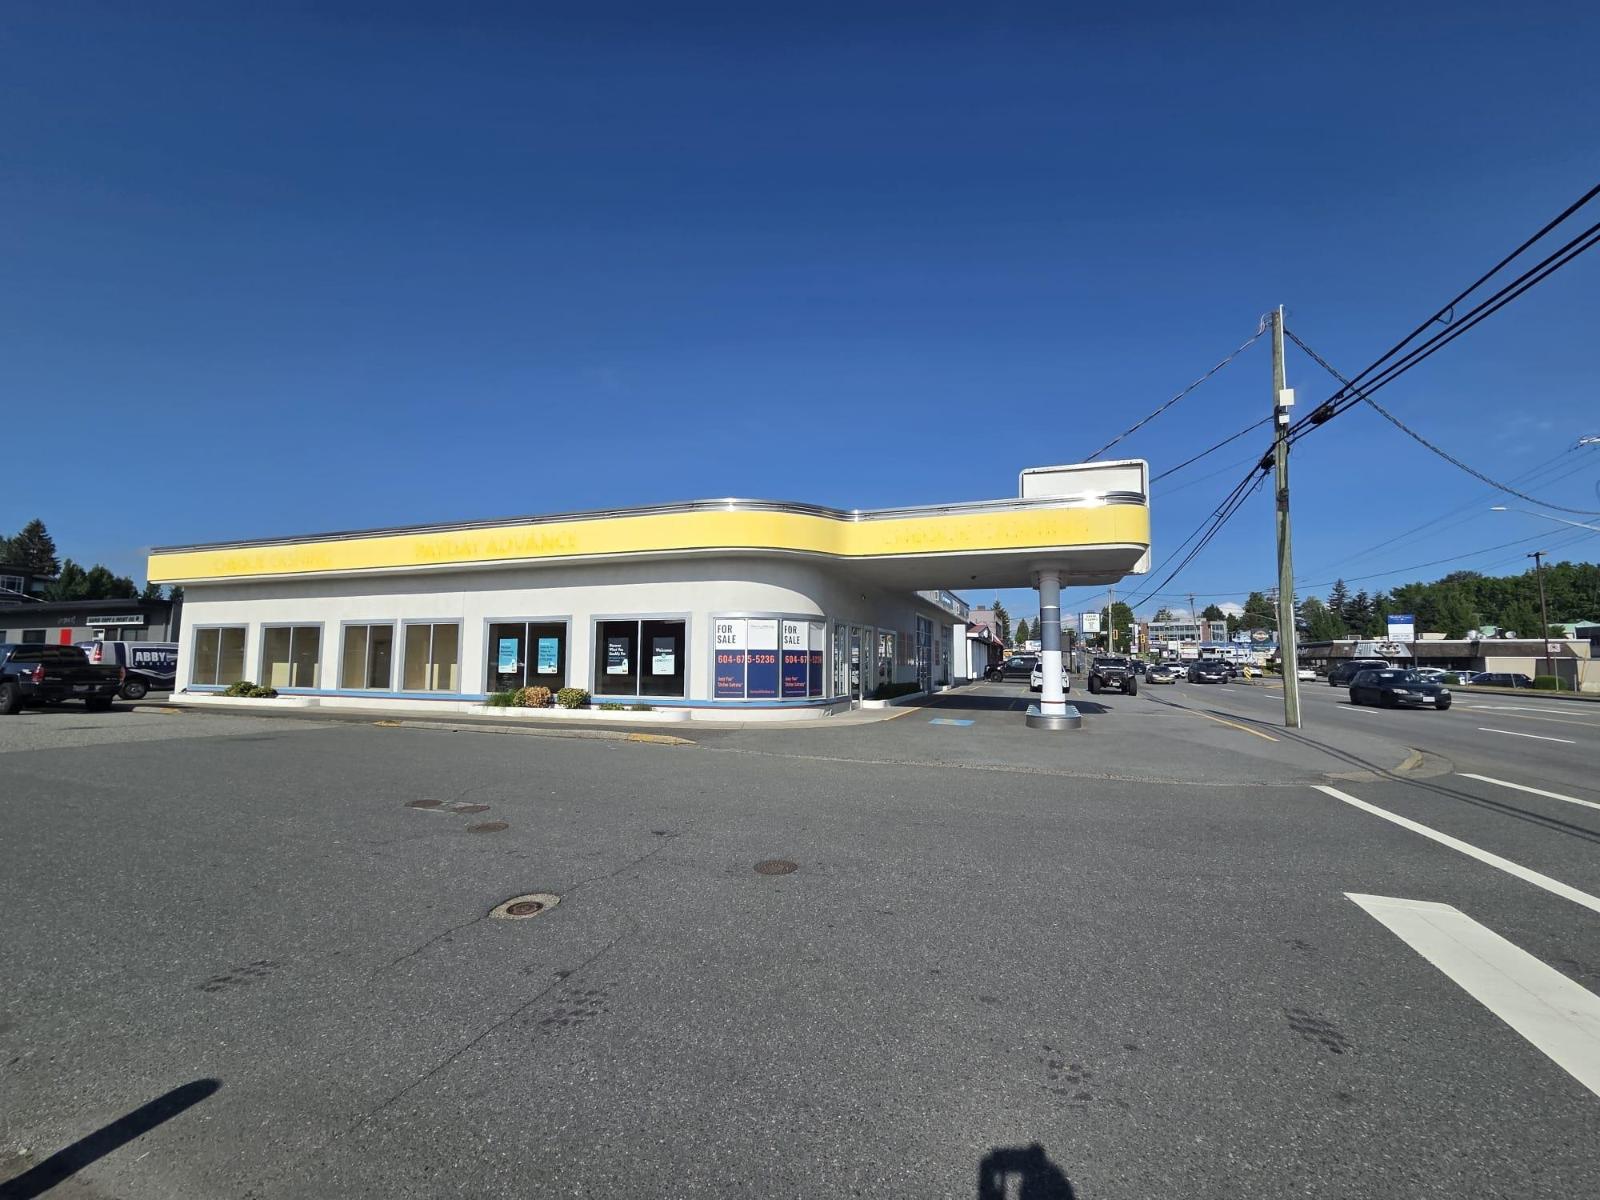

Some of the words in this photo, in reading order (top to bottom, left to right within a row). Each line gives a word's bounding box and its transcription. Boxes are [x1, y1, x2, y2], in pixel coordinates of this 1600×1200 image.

[717, 624, 733, 633] FOR
[784, 625, 797, 634] FOR
[717, 635, 736, 644] SALE
[784, 635, 800, 644] SALE
[135, 651, 166, 662] ABBY
